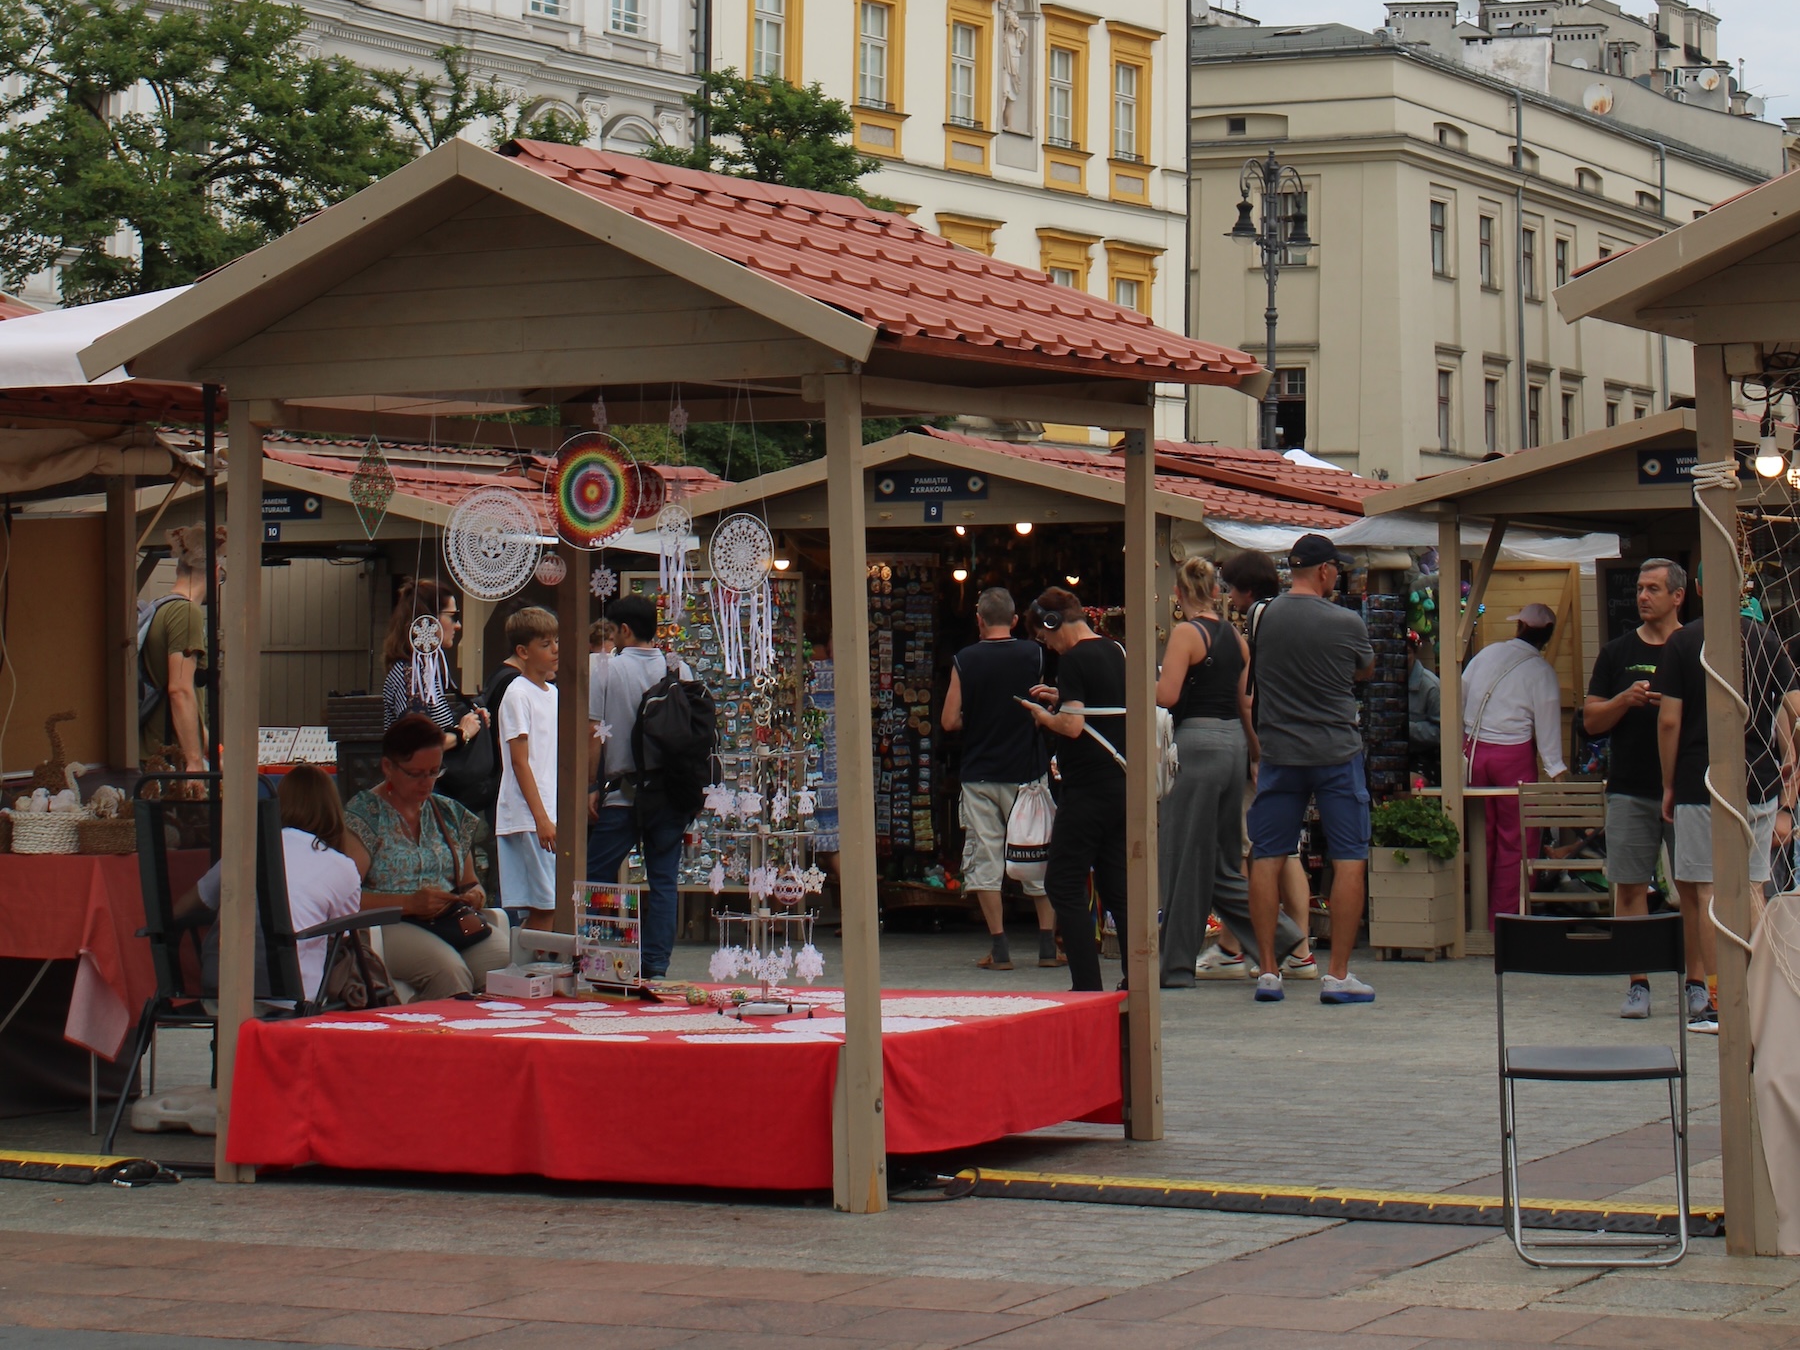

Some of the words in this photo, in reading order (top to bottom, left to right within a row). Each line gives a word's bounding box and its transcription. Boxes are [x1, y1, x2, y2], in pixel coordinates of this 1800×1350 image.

[914, 477, 948, 485] PAMIĄTKI
[931, 507, 937, 515] 9
[268, 528, 277, 536] 10
